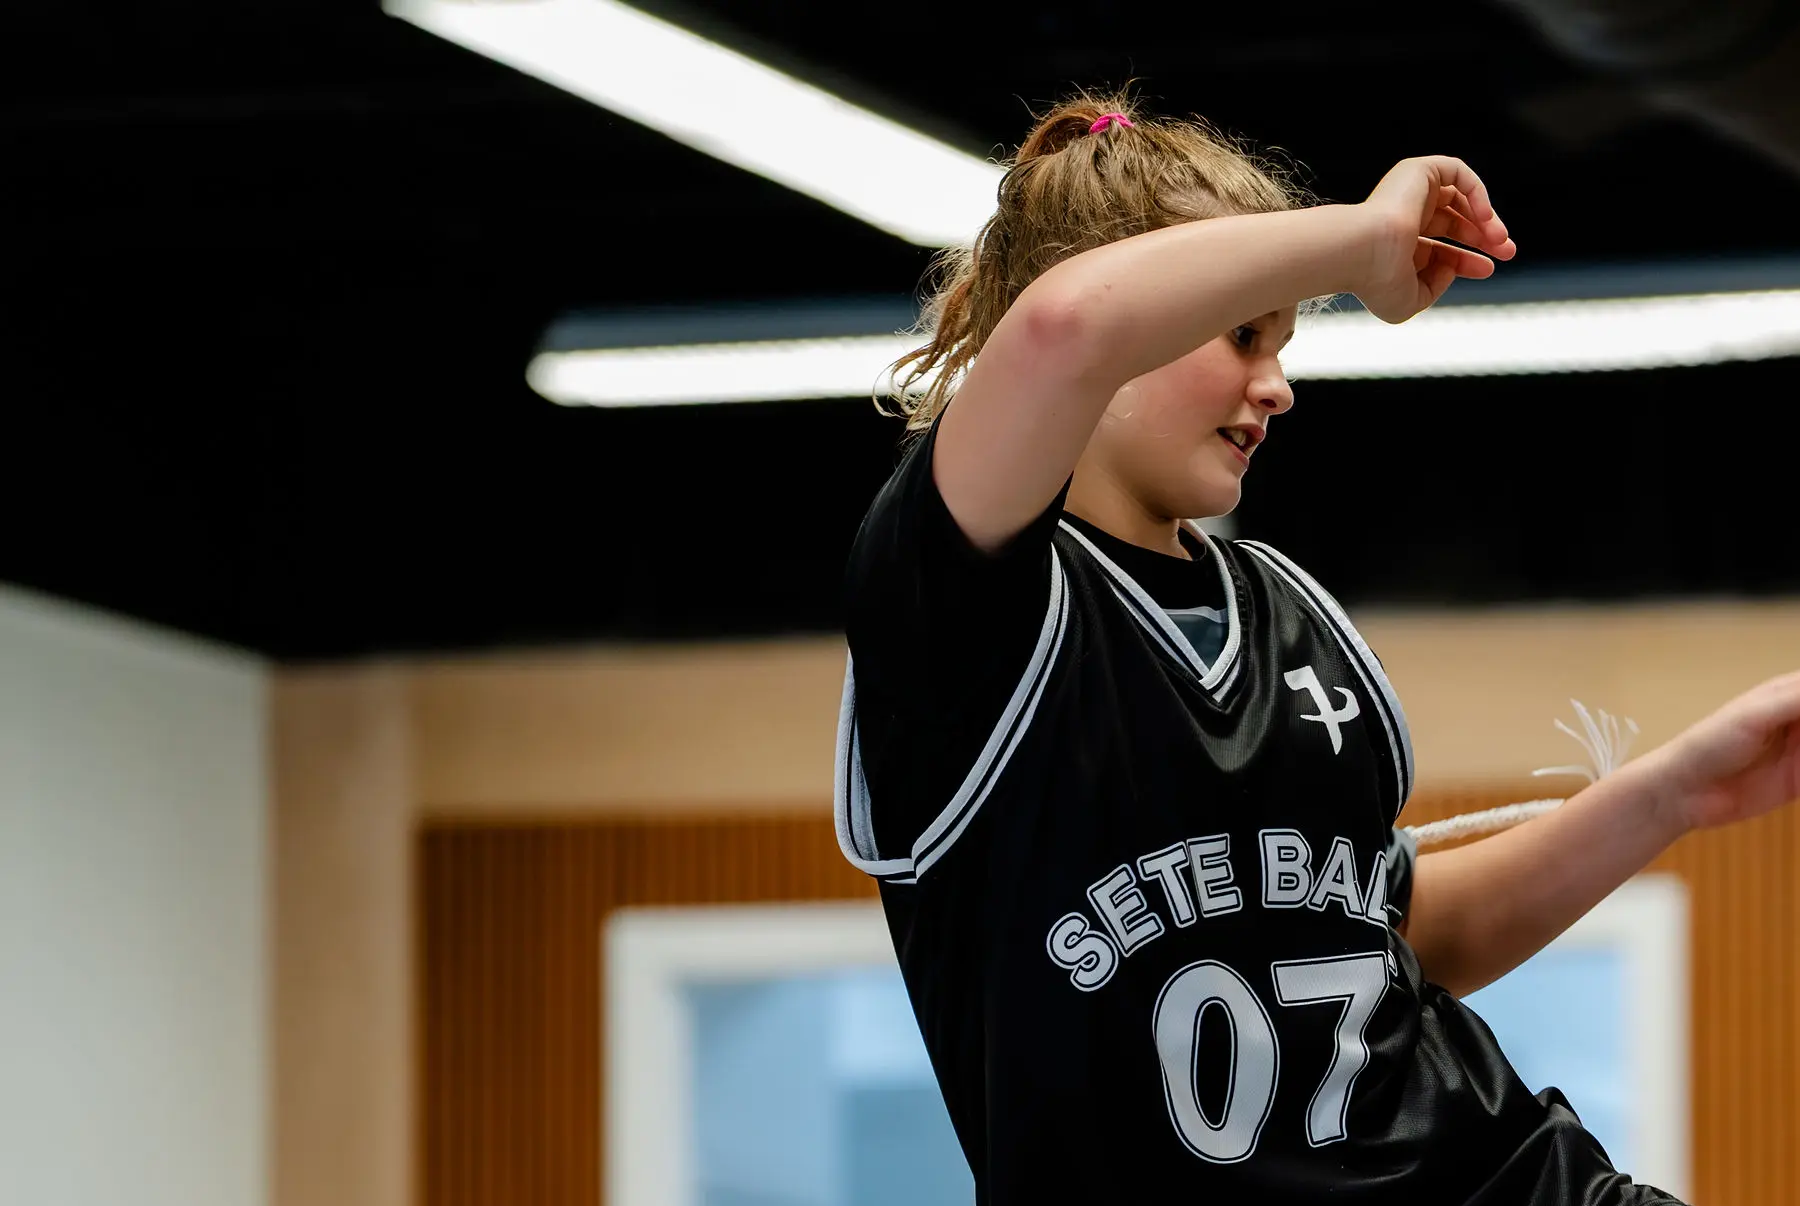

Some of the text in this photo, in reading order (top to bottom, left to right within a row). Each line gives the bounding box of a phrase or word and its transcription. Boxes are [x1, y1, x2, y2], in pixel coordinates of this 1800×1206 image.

[1046, 828, 1393, 992] SETE BAL
[1152, 951, 1390, 1164] 07
